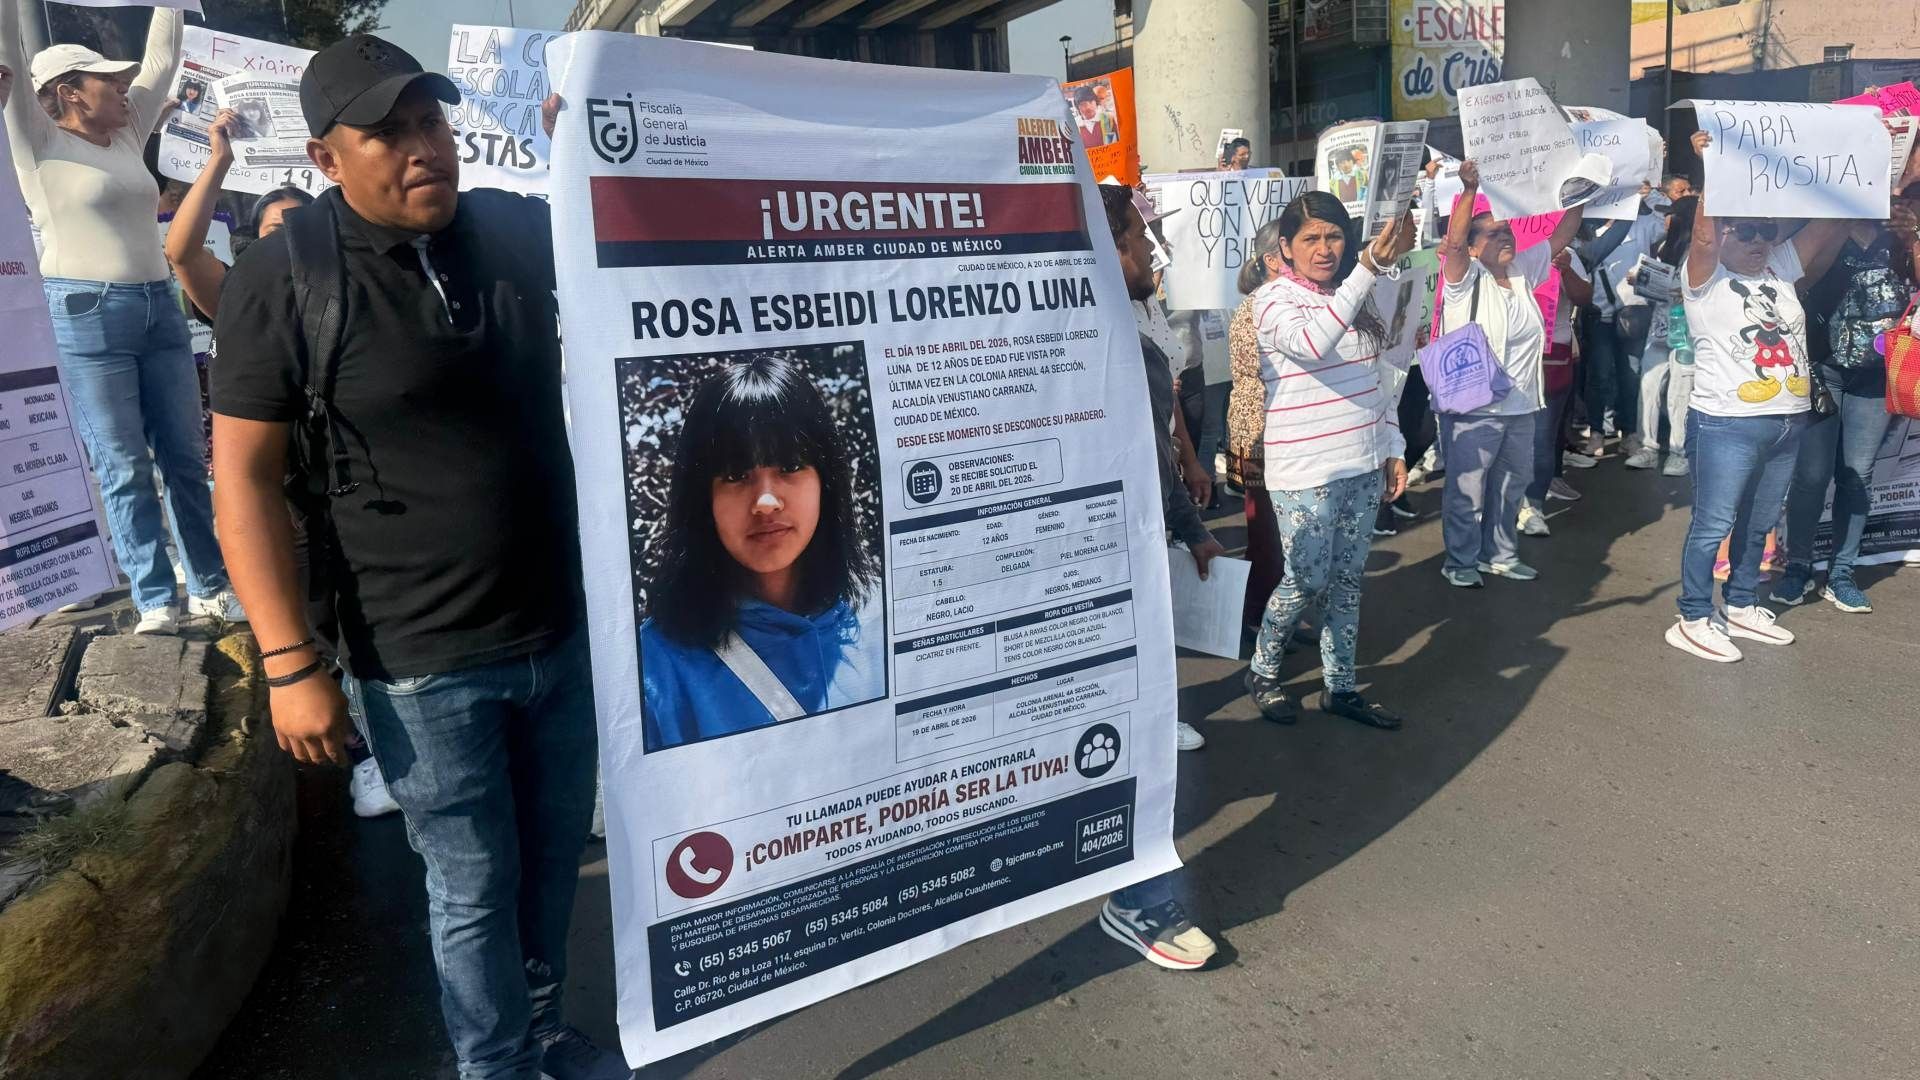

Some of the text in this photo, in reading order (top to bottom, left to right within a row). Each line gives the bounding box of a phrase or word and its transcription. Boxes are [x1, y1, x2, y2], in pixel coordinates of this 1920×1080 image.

[1416, 6, 1504, 41] ESCALE
[1404, 56, 1434, 96] de
[639, 101, 682, 115] Fiscalía
[643, 118, 688, 130] General
[1017, 117, 1058, 136] ALERTA
[1714, 110, 1796, 155] PARA
[644, 134, 706, 147] de Justicia
[1018, 136, 1074, 164] AMBER
[1582, 128, 1622, 148] Rosa
[170, 157, 192, 171] que
[646, 157, 708, 166] Ciudad de México
[1019, 166, 1039, 176] CIUDAD
[1041, 165, 1051, 175] DE
[280, 170, 313, 190] 19
[1750, 153, 1873, 196] ROSITA.
[1190, 180, 1239, 207] QUE
[761, 191, 985, 240] ¡URGENTE!
[1197, 207, 1240, 239] CON
[747, 237, 1002, 259] ALERTA AMBER CIUDAD DE MÉXICO
[958, 263, 984, 272] CIUDAD
[985, 262, 995, 271] DE
[997, 260, 1026, 270] MÉXICO,
[1027, 260, 1033, 268] A
[1034, 260, 1042, 268] 20
[1043, 259, 1053, 267] DE
[1054, 258, 1072, 267] ABRIL
[1074, 257, 1083, 266] DE
[632, 277, 1096, 339] ROSA ESBEIDI LORENZO LUNA
[885, 329, 1098, 358] EL DÍA 19 DE ABRIL DEL 2026, ROSA ESBEIDI LORENZO
[887, 347, 1065, 376] LUNA DE 12 AÑOS DE EDAD FUE VISTA POR
[889, 360, 1086, 392] ÚLTIMA VEZ EN LA COLONIA ARENAL 4A SECCIÓN,
[892, 382, 1037, 410] ALCALDÍA VENUSTIANO CARRANZA,
[894, 406, 980, 427] CIUDAD DE MÉXICO.
[897, 408, 1106, 449] DESDE ESE MOMENTO SE DESCONOCE SU PARADERO.
[948, 453, 1015, 471] OBSERVACIONES:
[949, 462, 1038, 484] SE RECIBE SOLICITUD EL
[951, 486, 961, 496] 20
[962, 485, 973, 494] DE
[974, 481, 998, 492] ABRIL
[999, 478, 1014, 489] DEL
[977, 495, 1052, 516] INFORMACIÓN GENERAL
[1035, 511, 1117, 534] FEMENINO MEXICANA
[919, 561, 1030, 577] ESTATURA: DELGADA
[912, 626, 984, 649] SEÑAS PARTICULARES
[1011, 673, 1038, 685] HECHOS
[786, 748, 1036, 828] TU LLAMADA PUEDE AYUDAR A ENCONTRARLA
[745, 755, 1068, 871] ¡COMPARTE, PODRÍA SER LA TUYA!
[825, 795, 1019, 861] TODOS AYUDANDO, TODOS BUSCANDO.
[1082, 814, 1123, 838] ALERTA
[1005, 841, 1065, 867] fgjcdmx.gob.mx
[1081, 830, 1123, 855] 404/2026
[699, 896, 888, 971] (55) 5345 5067 (55) 5345 5084
[674, 984, 697, 998] Calle
[752, 960, 772, 974] Loza
[794, 941, 826, 960] esquina
